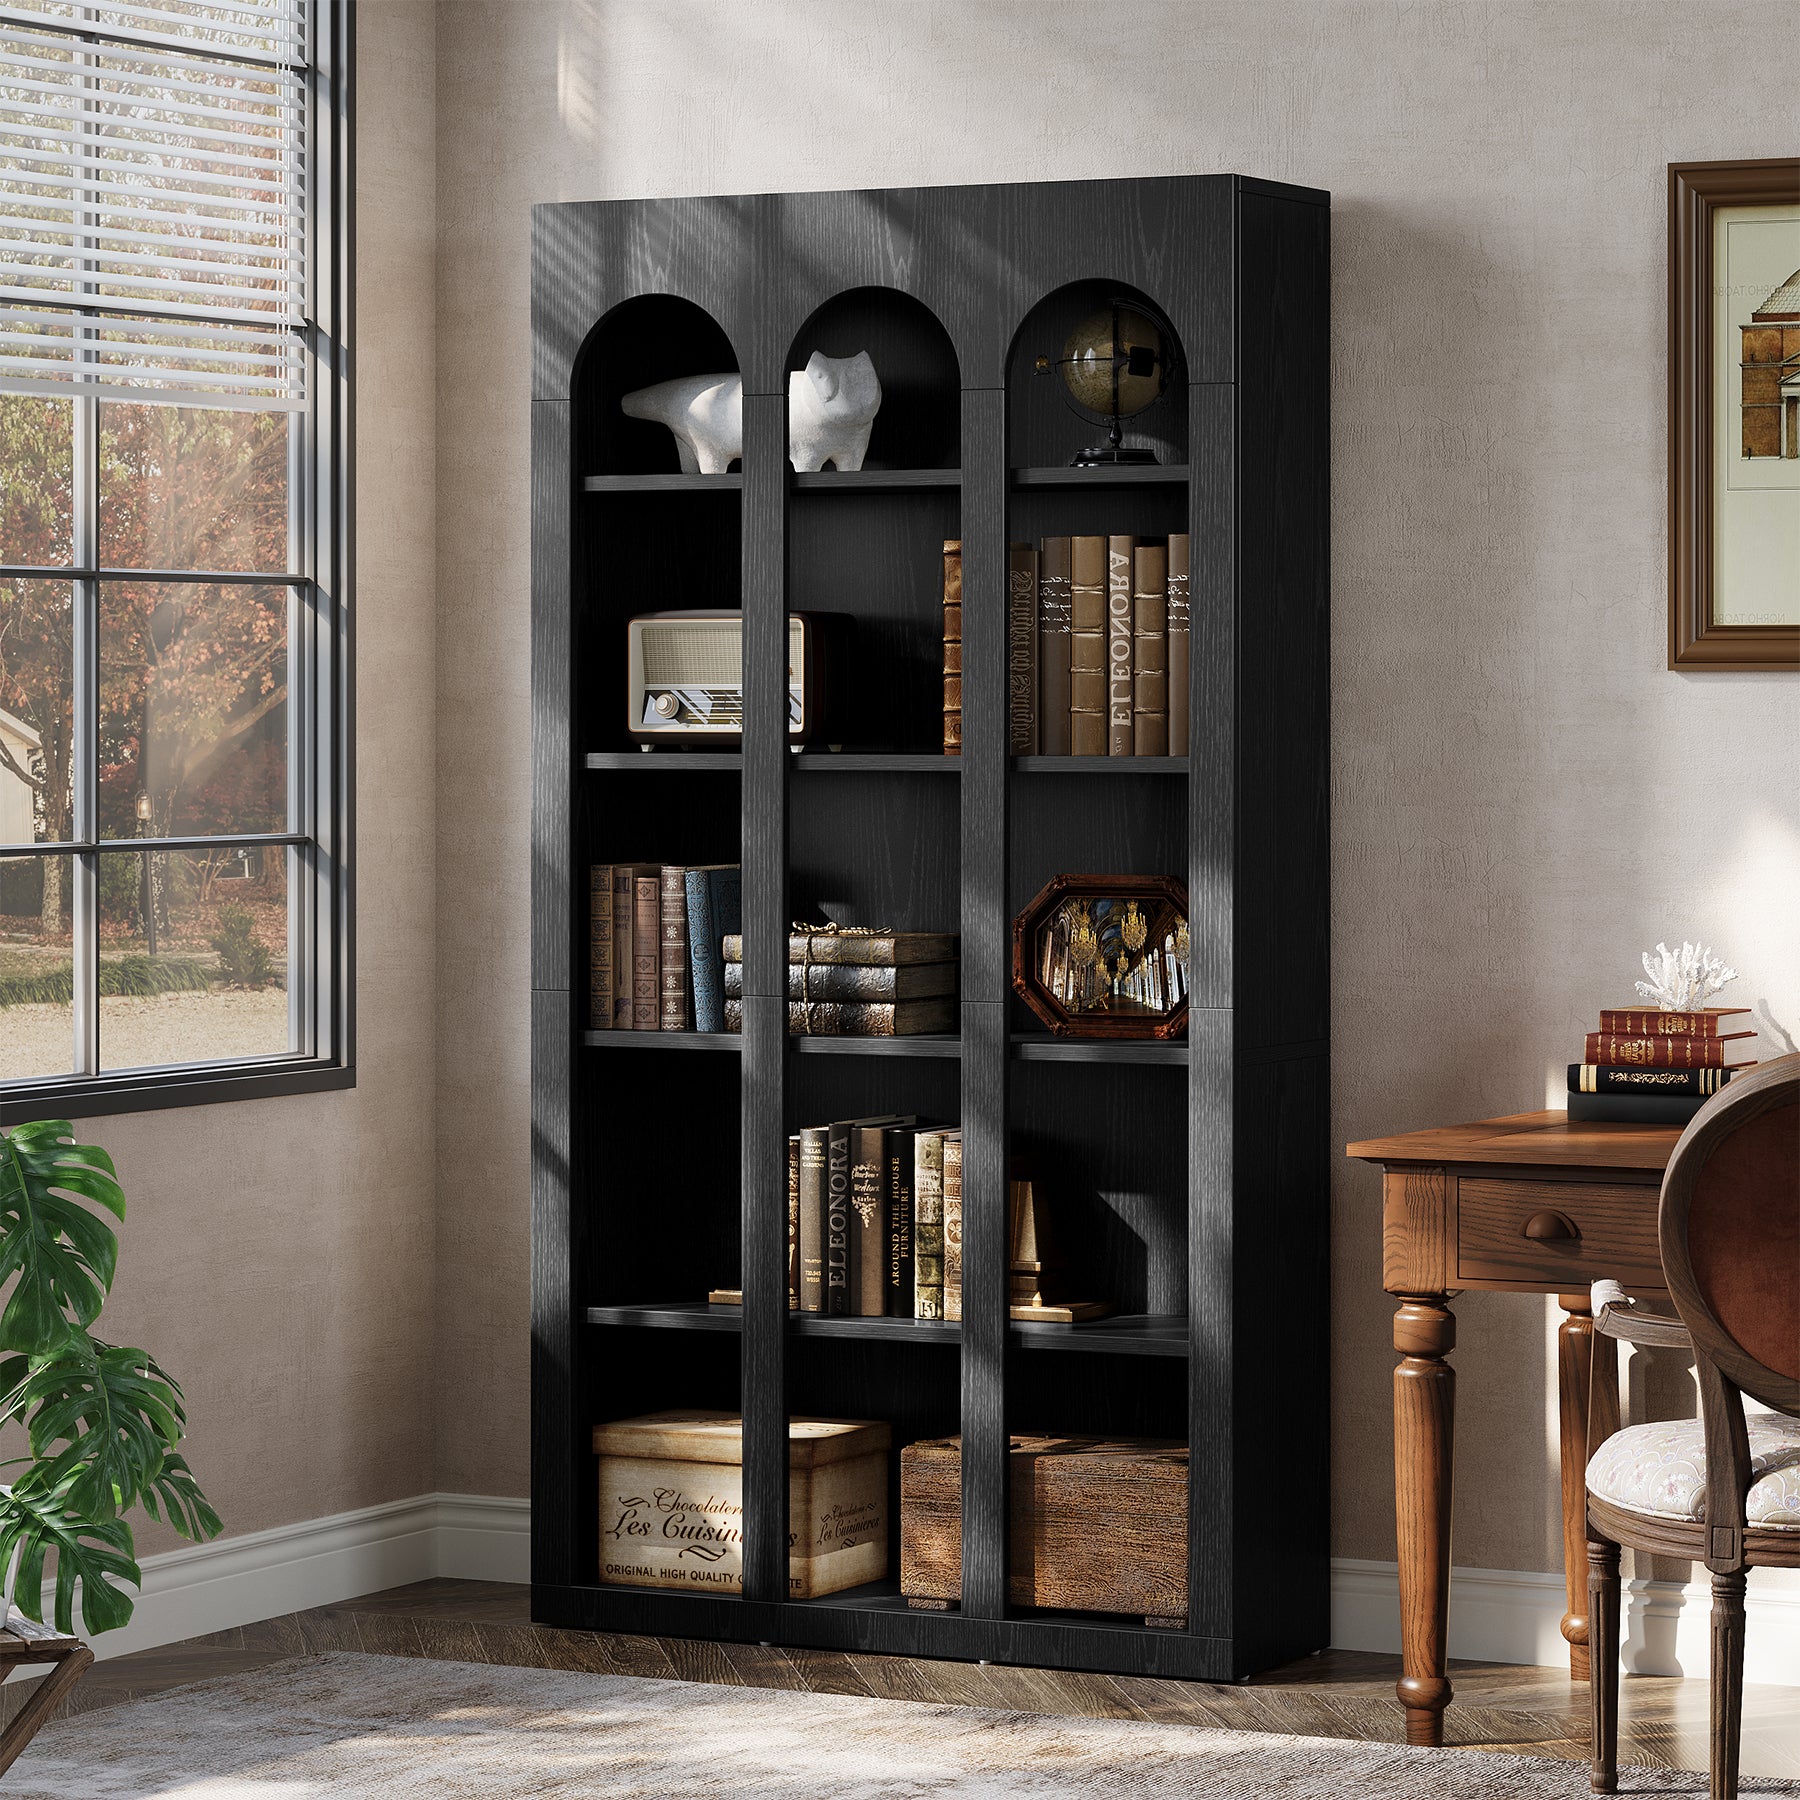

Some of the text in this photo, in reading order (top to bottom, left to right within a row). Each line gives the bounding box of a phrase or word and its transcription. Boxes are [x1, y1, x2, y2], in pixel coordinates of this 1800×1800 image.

[828, 1136, 849, 1289] ELEONORA
[892, 1203, 900, 1229] THE
[900, 1186, 909, 1258] FURNITURE
[891, 1232, 900, 1287] AROUND
[605, 1509, 654, 1540] Les
[606, 1563, 656, 1578] ORIGINAL
[660, 1568, 687, 1580] HIGH
[690, 1570, 734, 1584] QUALITY
